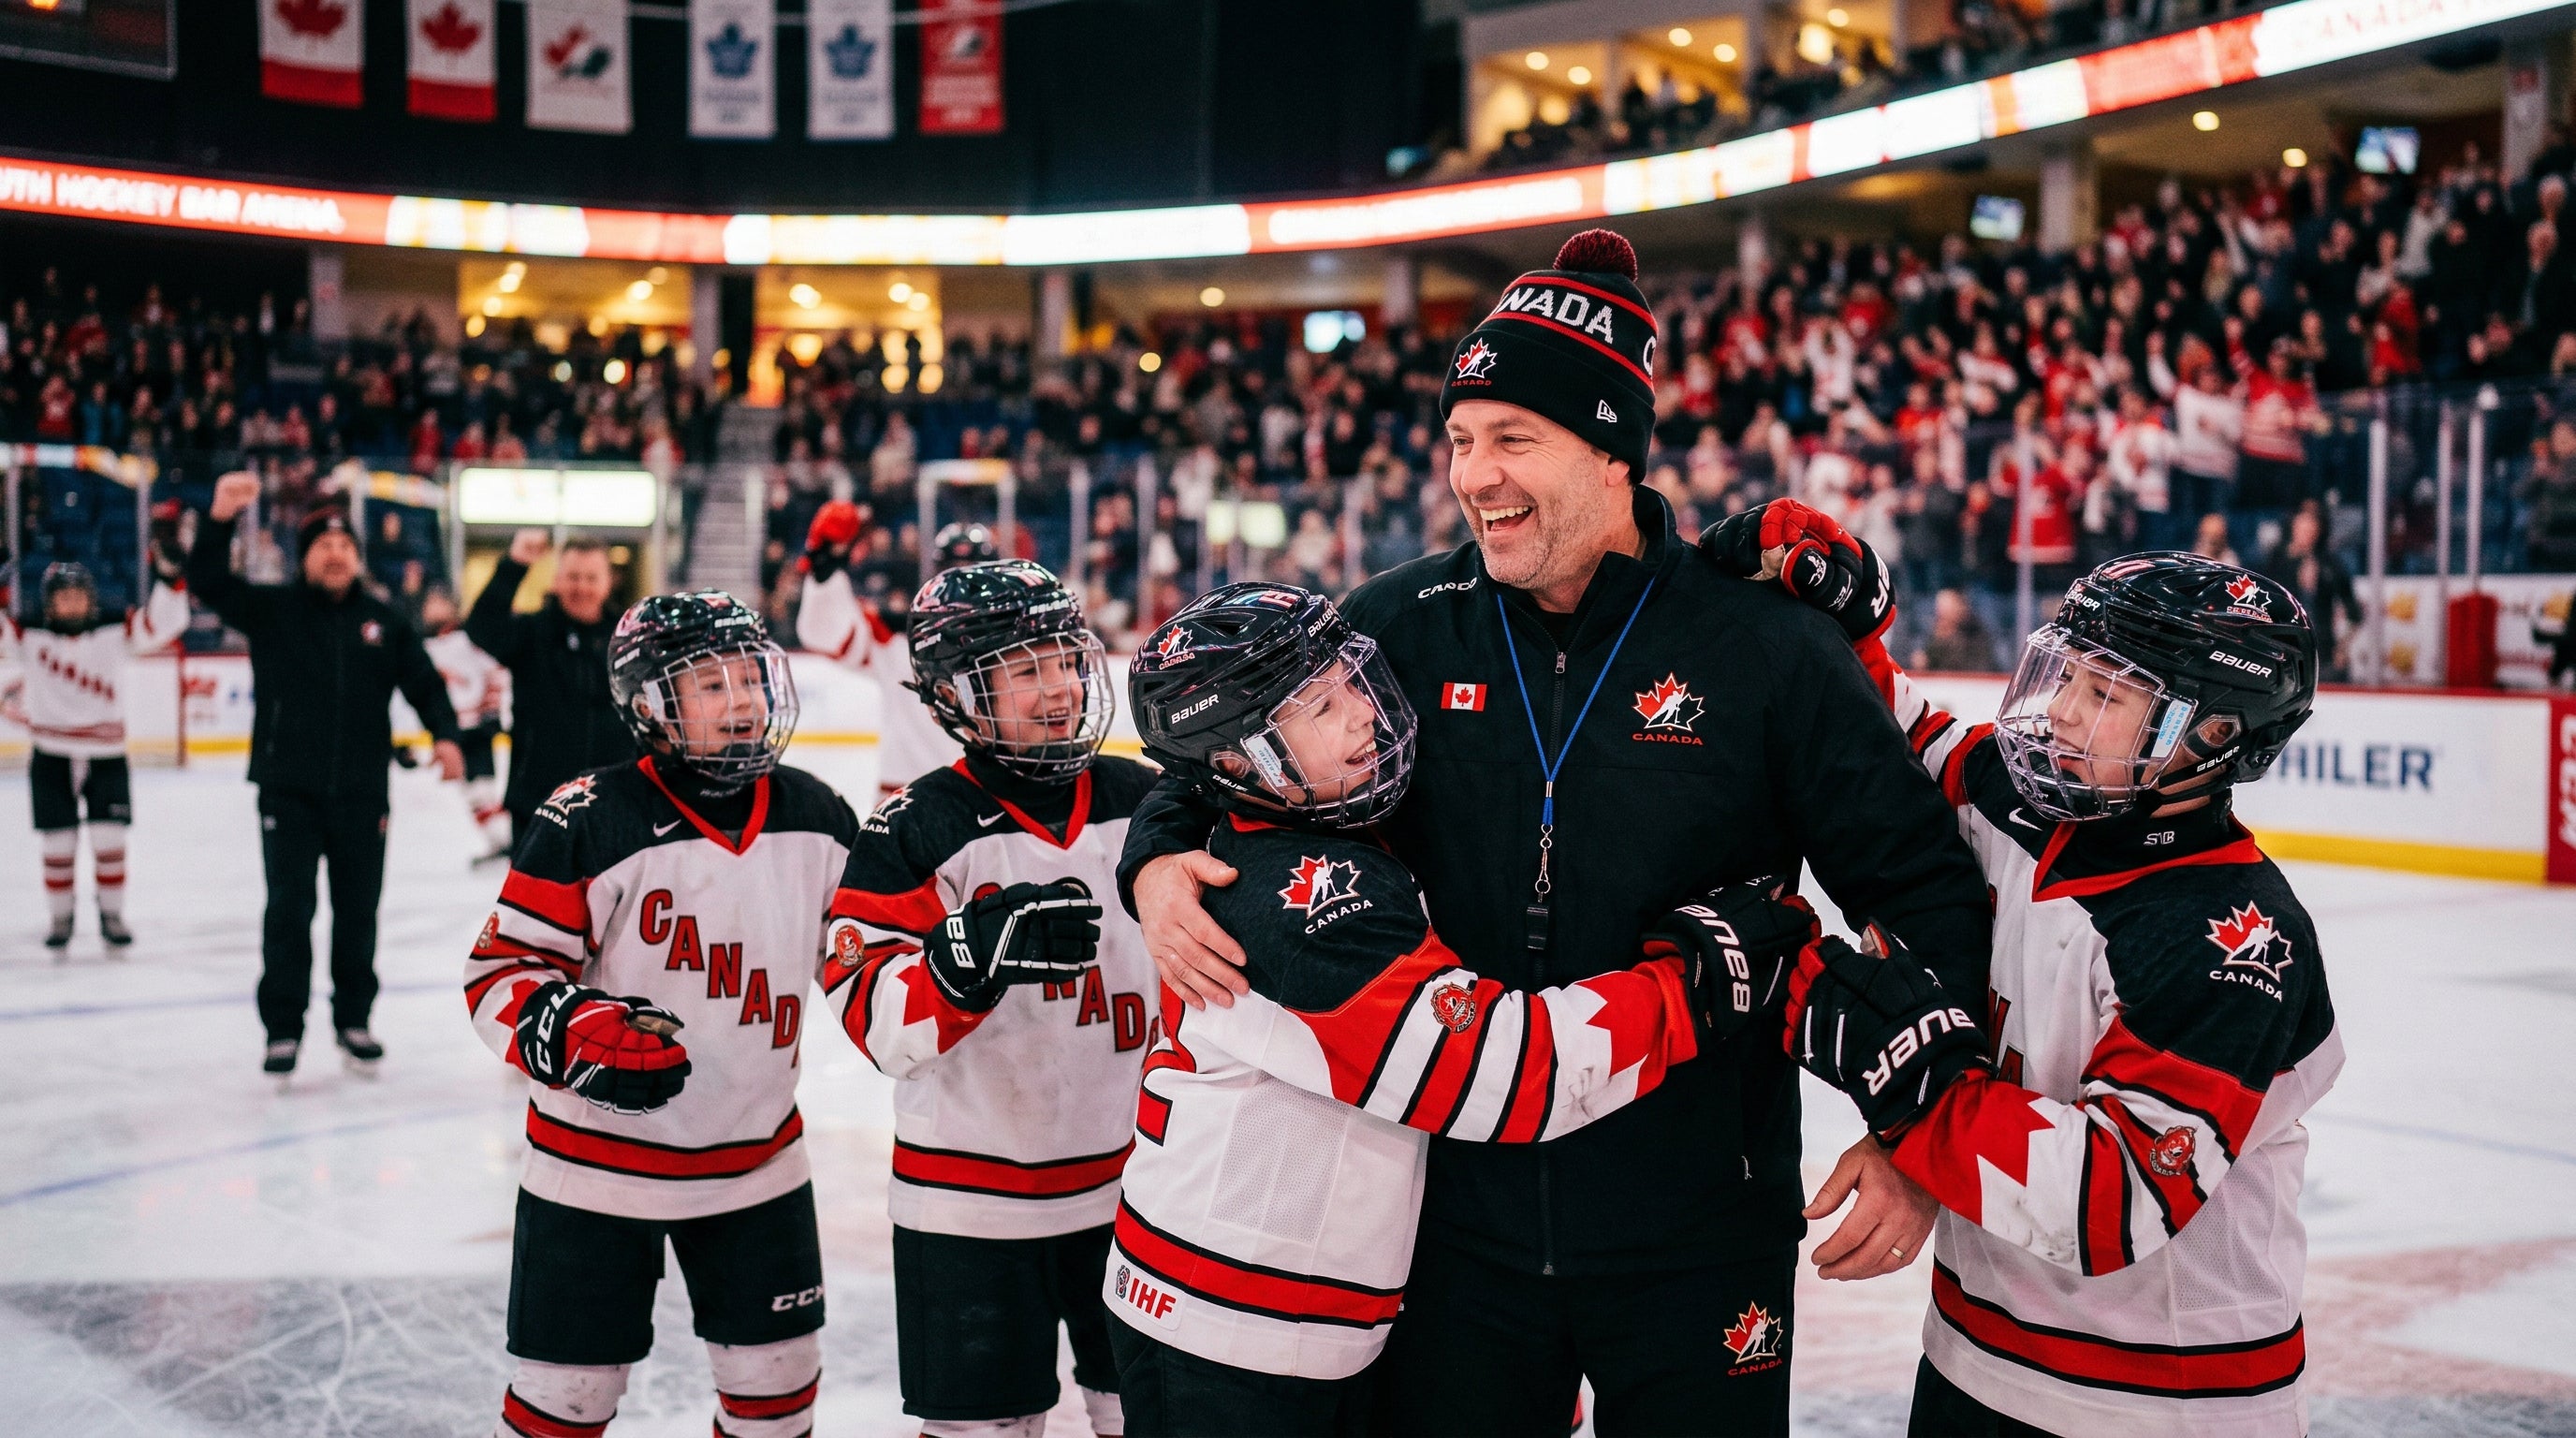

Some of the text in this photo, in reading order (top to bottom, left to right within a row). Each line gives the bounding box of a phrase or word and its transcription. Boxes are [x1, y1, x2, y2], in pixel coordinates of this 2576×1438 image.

[55, 172, 177, 218] HOCKEY
[1492, 287, 1614, 345] NADA
[2209, 651, 2273, 679] BAUER
[1171, 694, 1220, 725] BAUER
[1632, 733, 1704, 746] CANADA
[1304, 899, 1373, 934] CANADA
[639, 888, 801, 1069] CANAD
[2209, 970, 2283, 1003] CANADA
[1727, 1357, 1783, 1376] CANADA
